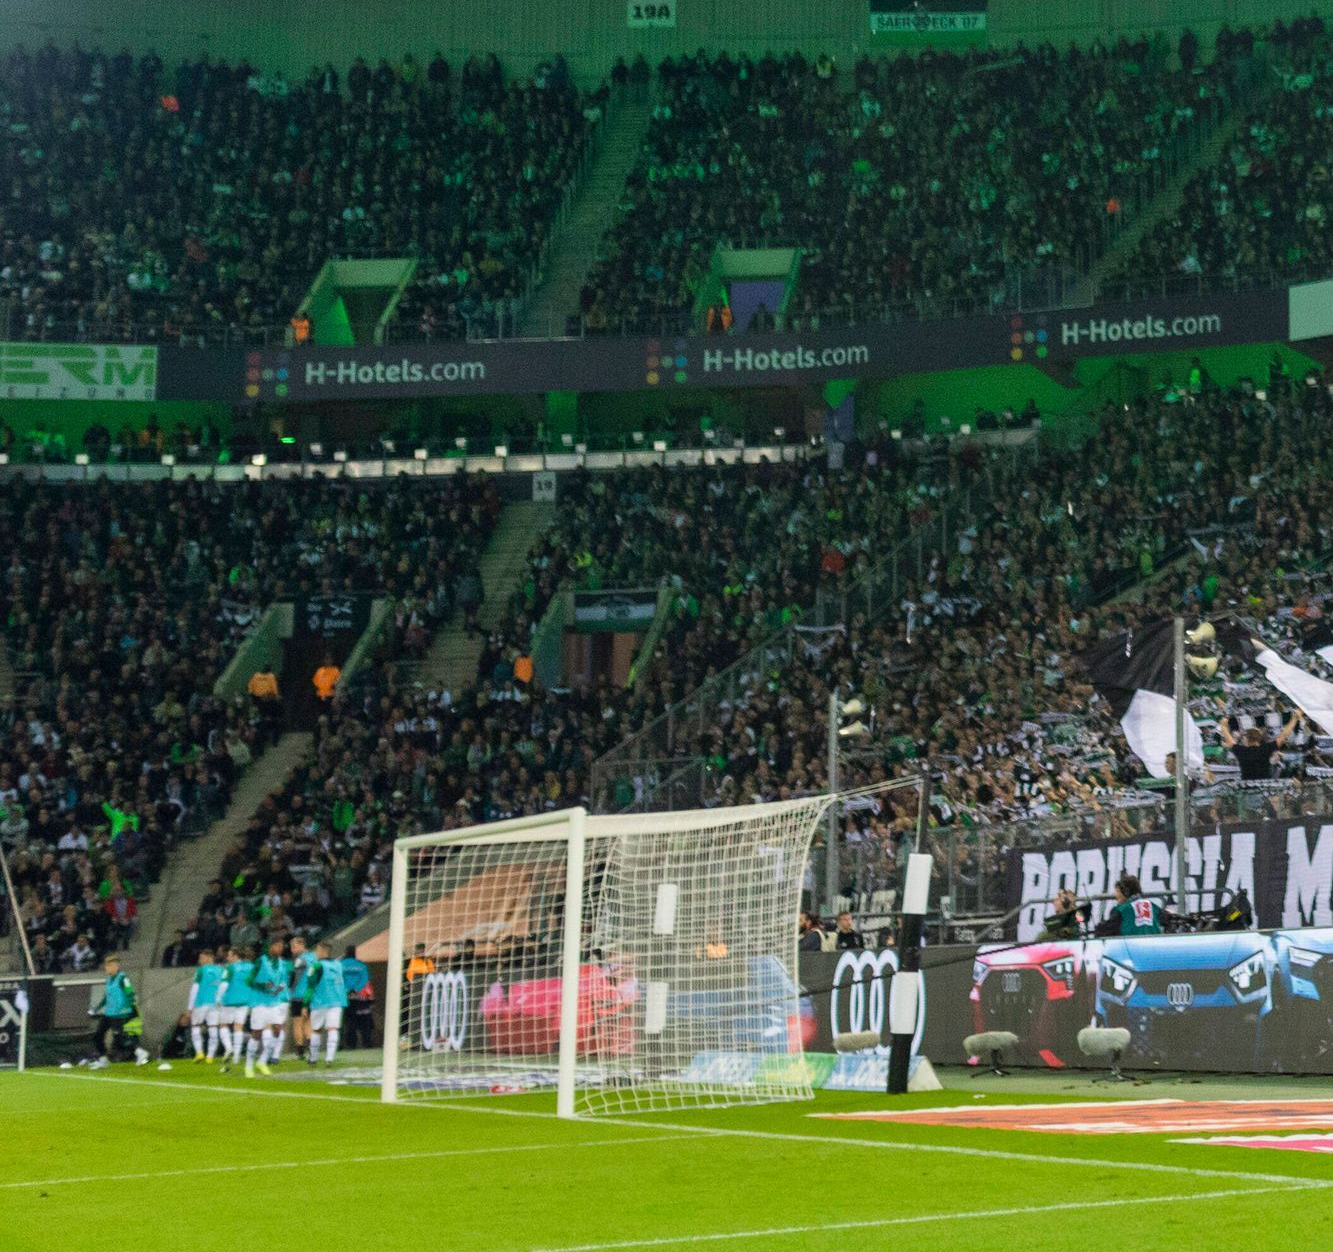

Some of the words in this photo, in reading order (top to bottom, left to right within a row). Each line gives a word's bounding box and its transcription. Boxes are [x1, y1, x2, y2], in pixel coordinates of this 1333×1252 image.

[632, 3, 671, 21] 19A
[1061, 312, 1223, 346] H-Hotels.com
[703, 342, 871, 371] H-Hotels.com
[305, 358, 486, 386] H-Hotels.com
